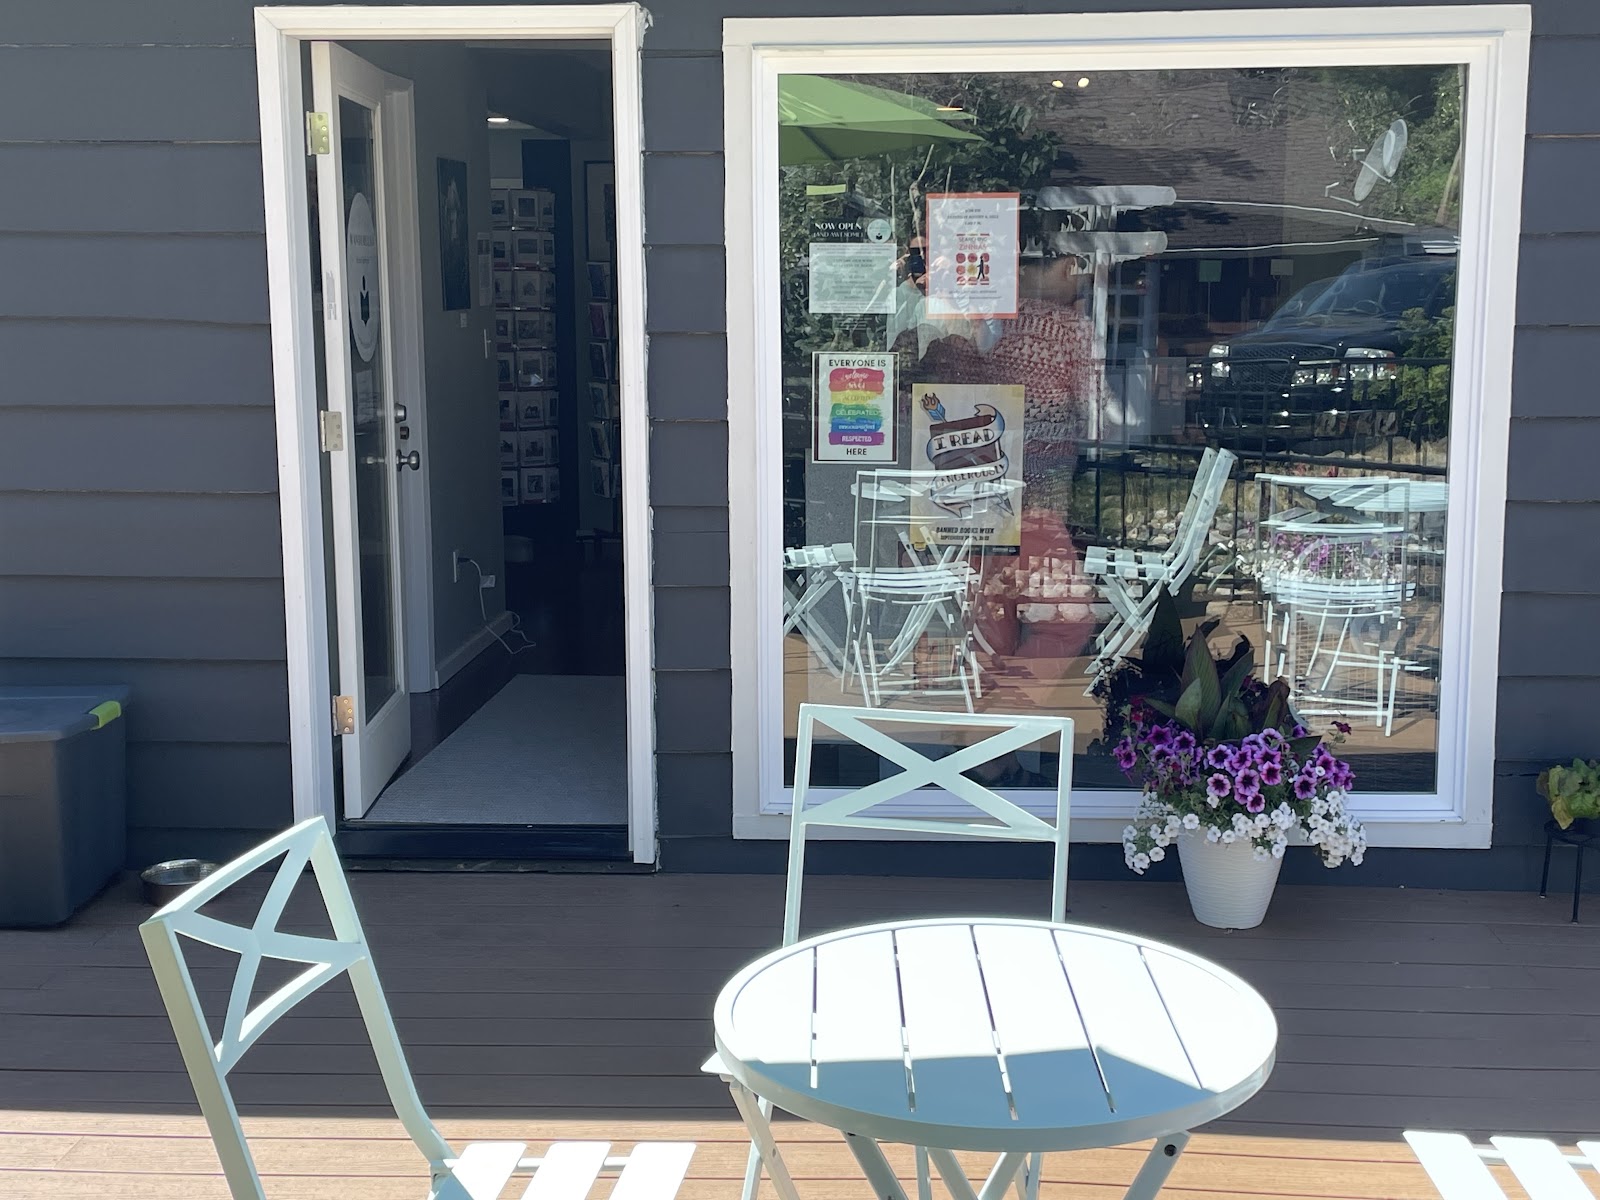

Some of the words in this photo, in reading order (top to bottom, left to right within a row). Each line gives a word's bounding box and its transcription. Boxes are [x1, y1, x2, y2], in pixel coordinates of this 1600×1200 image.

[814, 222, 836, 230] NOW
[838, 222, 862, 230] OPEN
[828, 359, 876, 367] EVERYONE
[877, 359, 887, 367] IS
[835, 408, 880, 416] CELEBRATED
[933, 436, 947, 450] I
[948, 427, 996, 447] READ
[846, 447, 868, 456] HERE
[935, 526, 959, 534] BANNED
